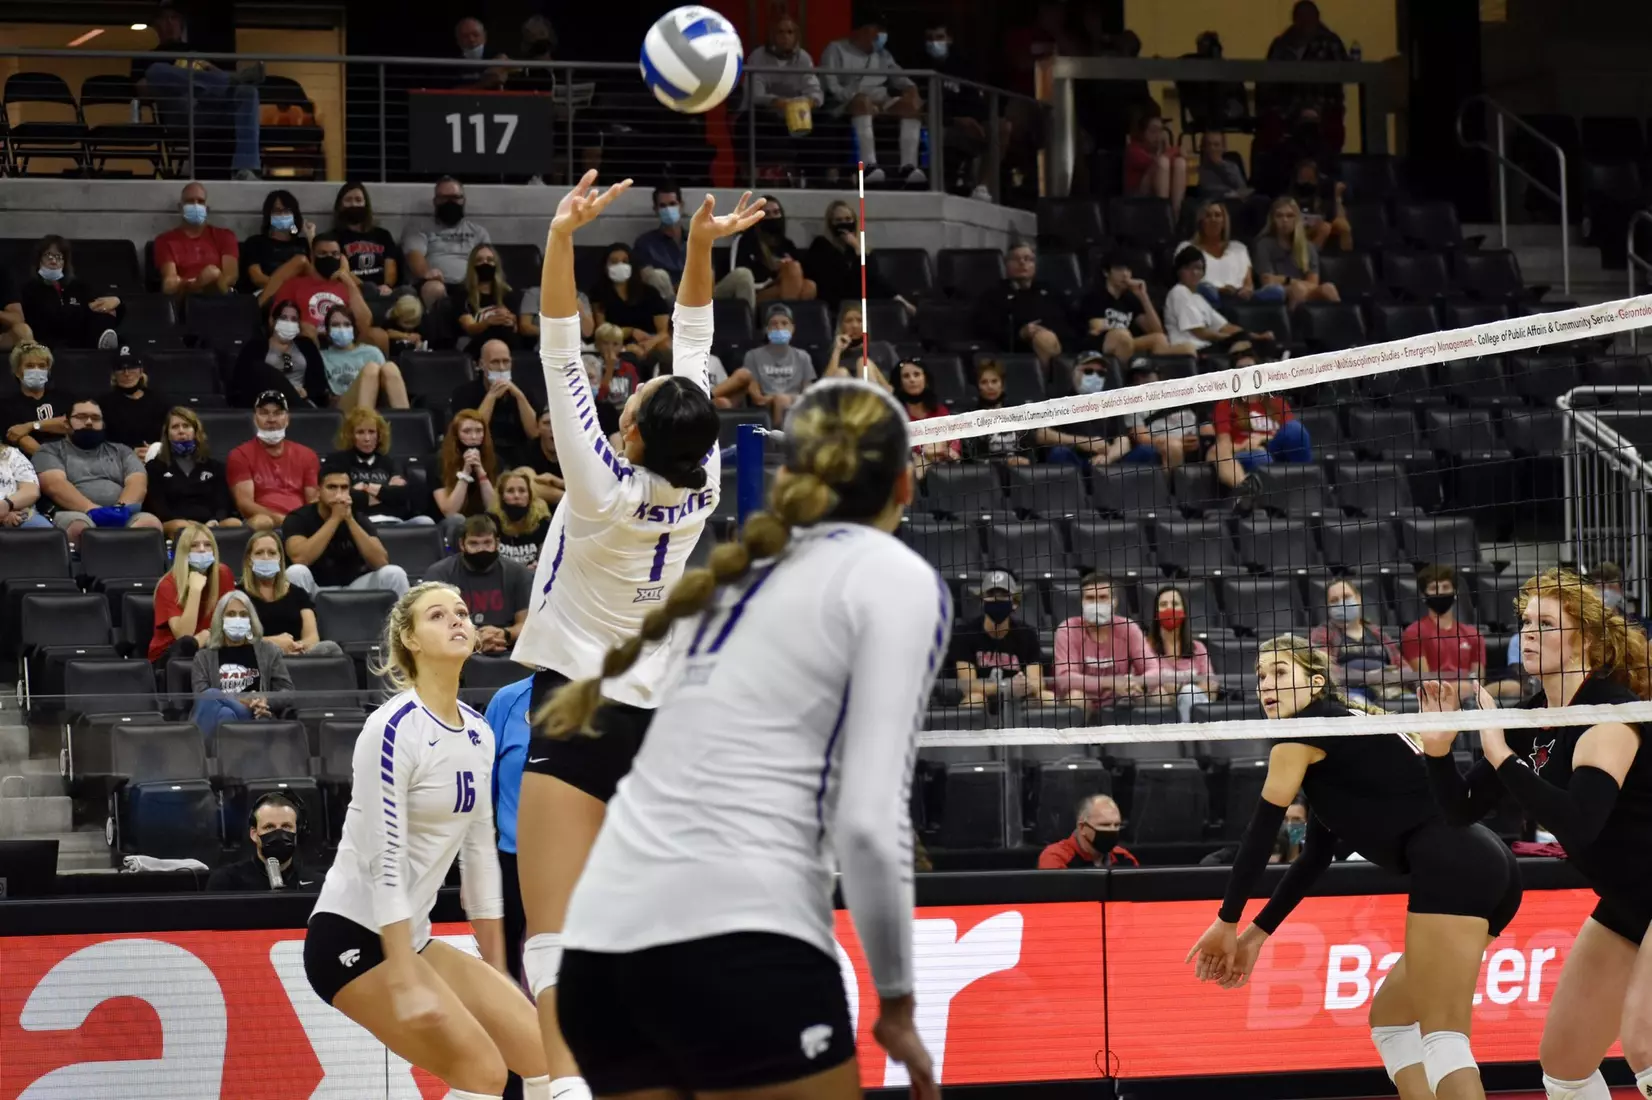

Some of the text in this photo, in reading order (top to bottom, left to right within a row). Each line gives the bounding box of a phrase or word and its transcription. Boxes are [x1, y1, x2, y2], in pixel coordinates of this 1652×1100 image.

[444, 112, 520, 155] 117
[1267, 370, 1288, 382] Aviation
[1290, 366, 1315, 378] Criminal
[1314, 362, 1333, 375] Justice
[1334, 352, 1382, 372] Multidisciplinary
[1380, 349, 1401, 362] Studies
[1403, 345, 1437, 359] Emergency
[1437, 337, 1475, 352] Management
[1477, 332, 1500, 347] College
[1500, 331, 1509, 342] of
[1508, 327, 1527, 341] Public
[1526, 323, 1548, 337] Affairs
[1547, 321, 1555, 334] &
[1554, 316, 1592, 332] Community
[1591, 311, 1616, 326] Service
[976, 417, 993, 428] College
[1027, 406, 1055, 420] Community
[1071, 400, 1099, 414] Gerontology
[1123, 394, 1143, 406] Scholars
[1145, 391, 1161, 402] Public
[1160, 386, 1195, 400] Administration
[1197, 380, 1214, 394] Social
[1213, 380, 1229, 391] Work
[498, 542, 538, 557] OMAHA
[648, 532, 671, 583] 1
[452, 770, 476, 814] 16
[1323, 944, 1557, 1011] Baer
